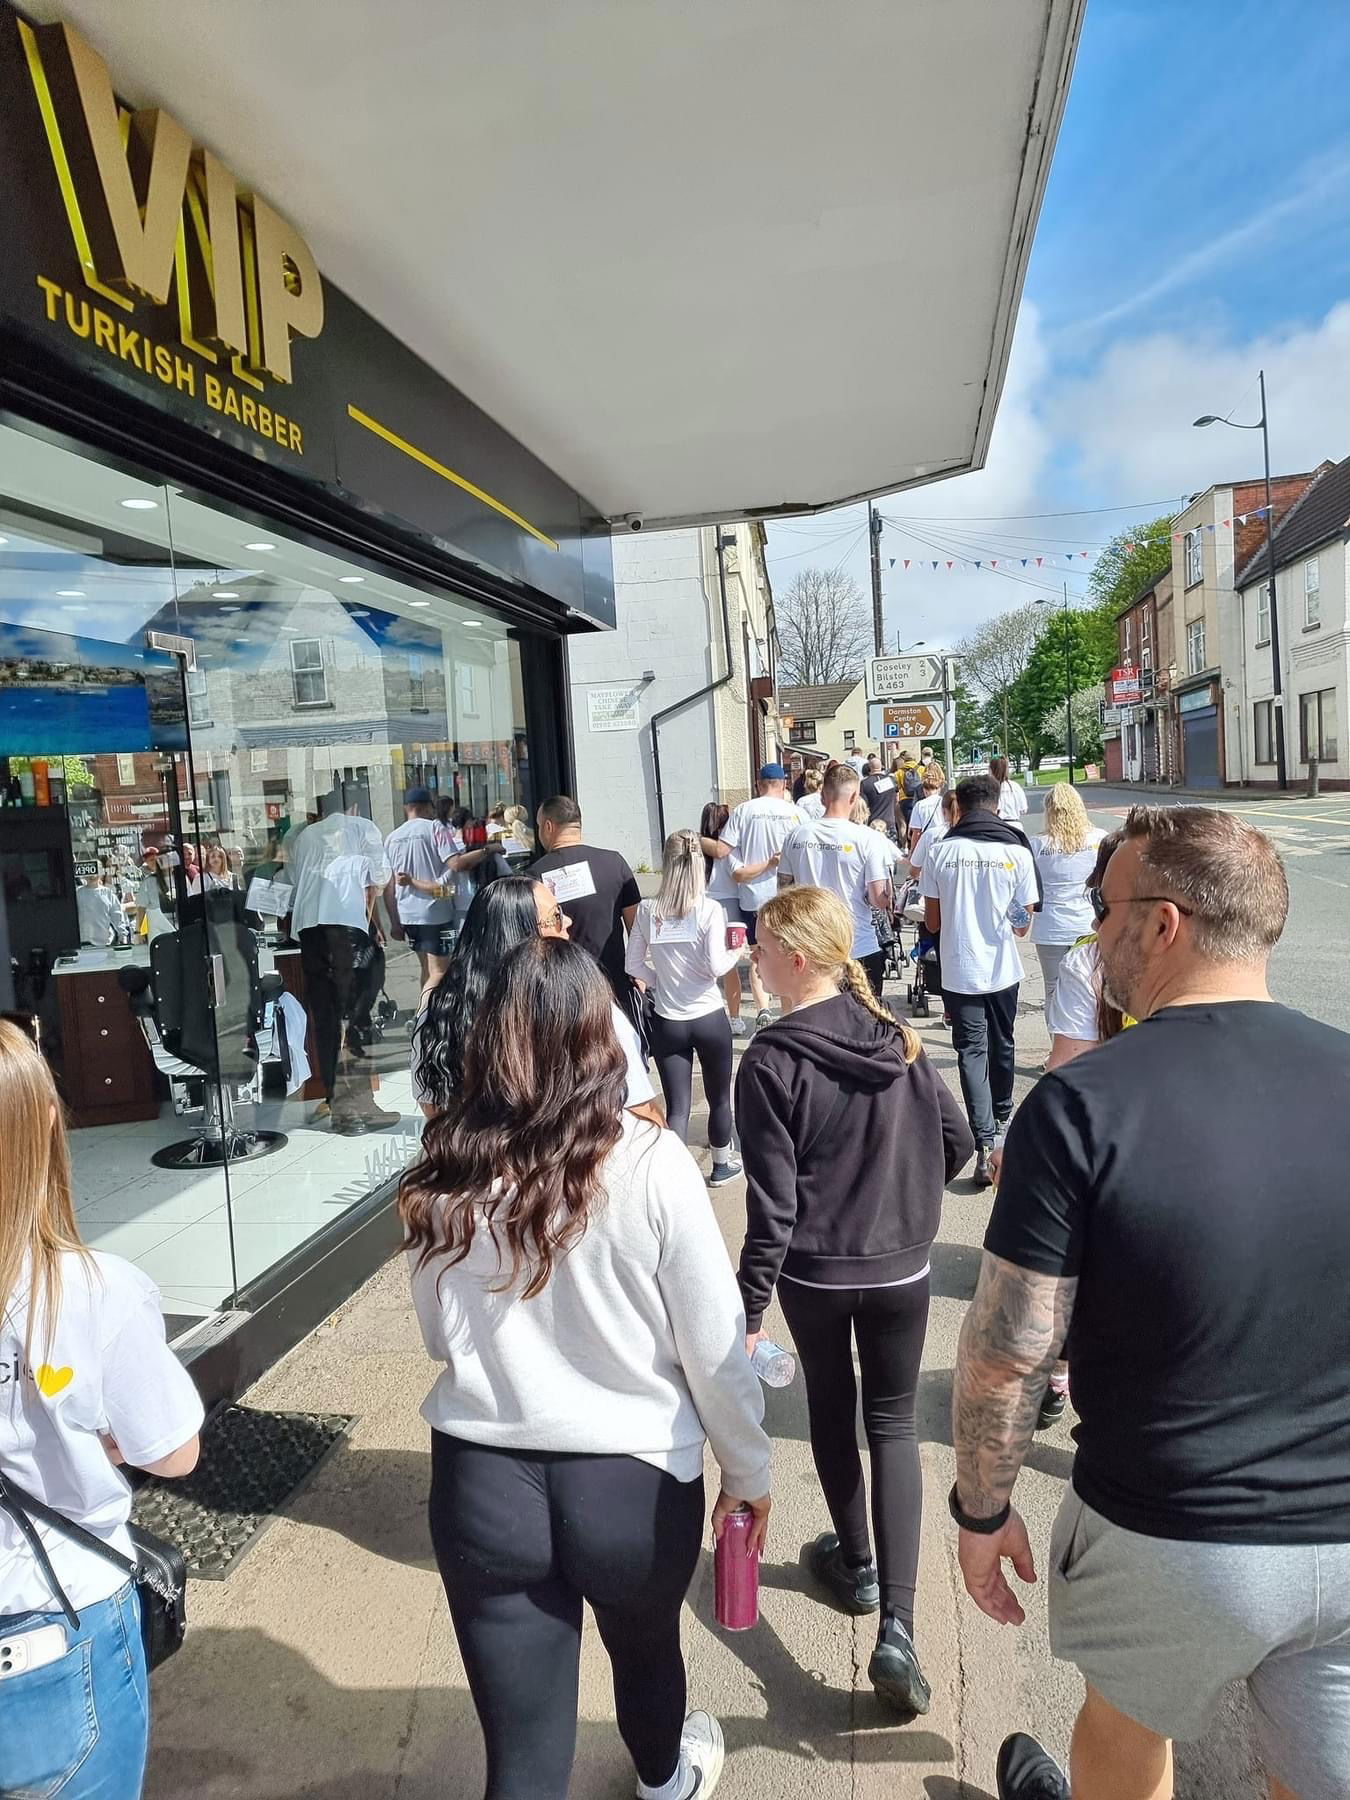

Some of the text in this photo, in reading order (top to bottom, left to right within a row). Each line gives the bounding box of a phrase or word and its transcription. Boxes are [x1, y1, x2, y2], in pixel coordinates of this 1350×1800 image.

[20, 18, 325, 389] VIP
[37, 275, 304, 456] TURKISH BARBER
[876, 663, 912, 672] Coseley
[1116, 668, 1134, 677] TSR
[876, 669, 926, 681] Bilston 3
[888, 707, 921, 715] Dormston
[945, 857, 1004, 871] #alforgracie
